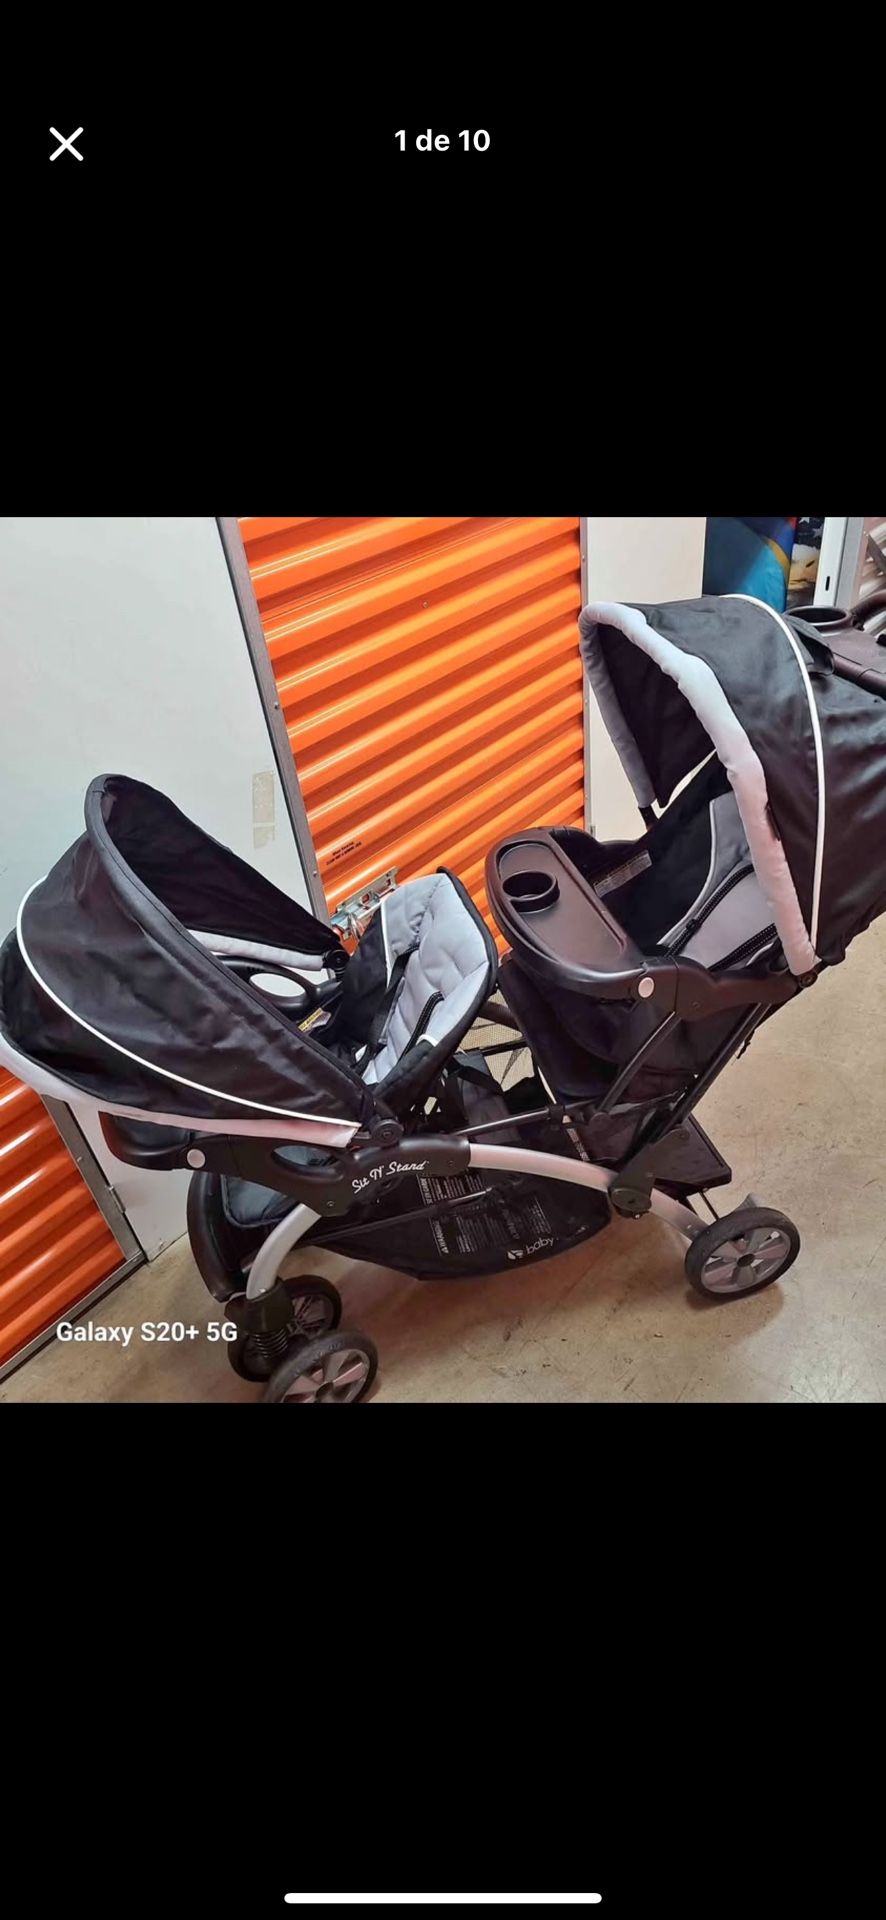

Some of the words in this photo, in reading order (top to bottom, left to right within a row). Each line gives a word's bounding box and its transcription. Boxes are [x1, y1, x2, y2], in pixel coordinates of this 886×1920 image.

[352, 1178, 370, 1194] Sit
[386, 1160, 427, 1176] Stand
[525, 1237, 554, 1254] baby
